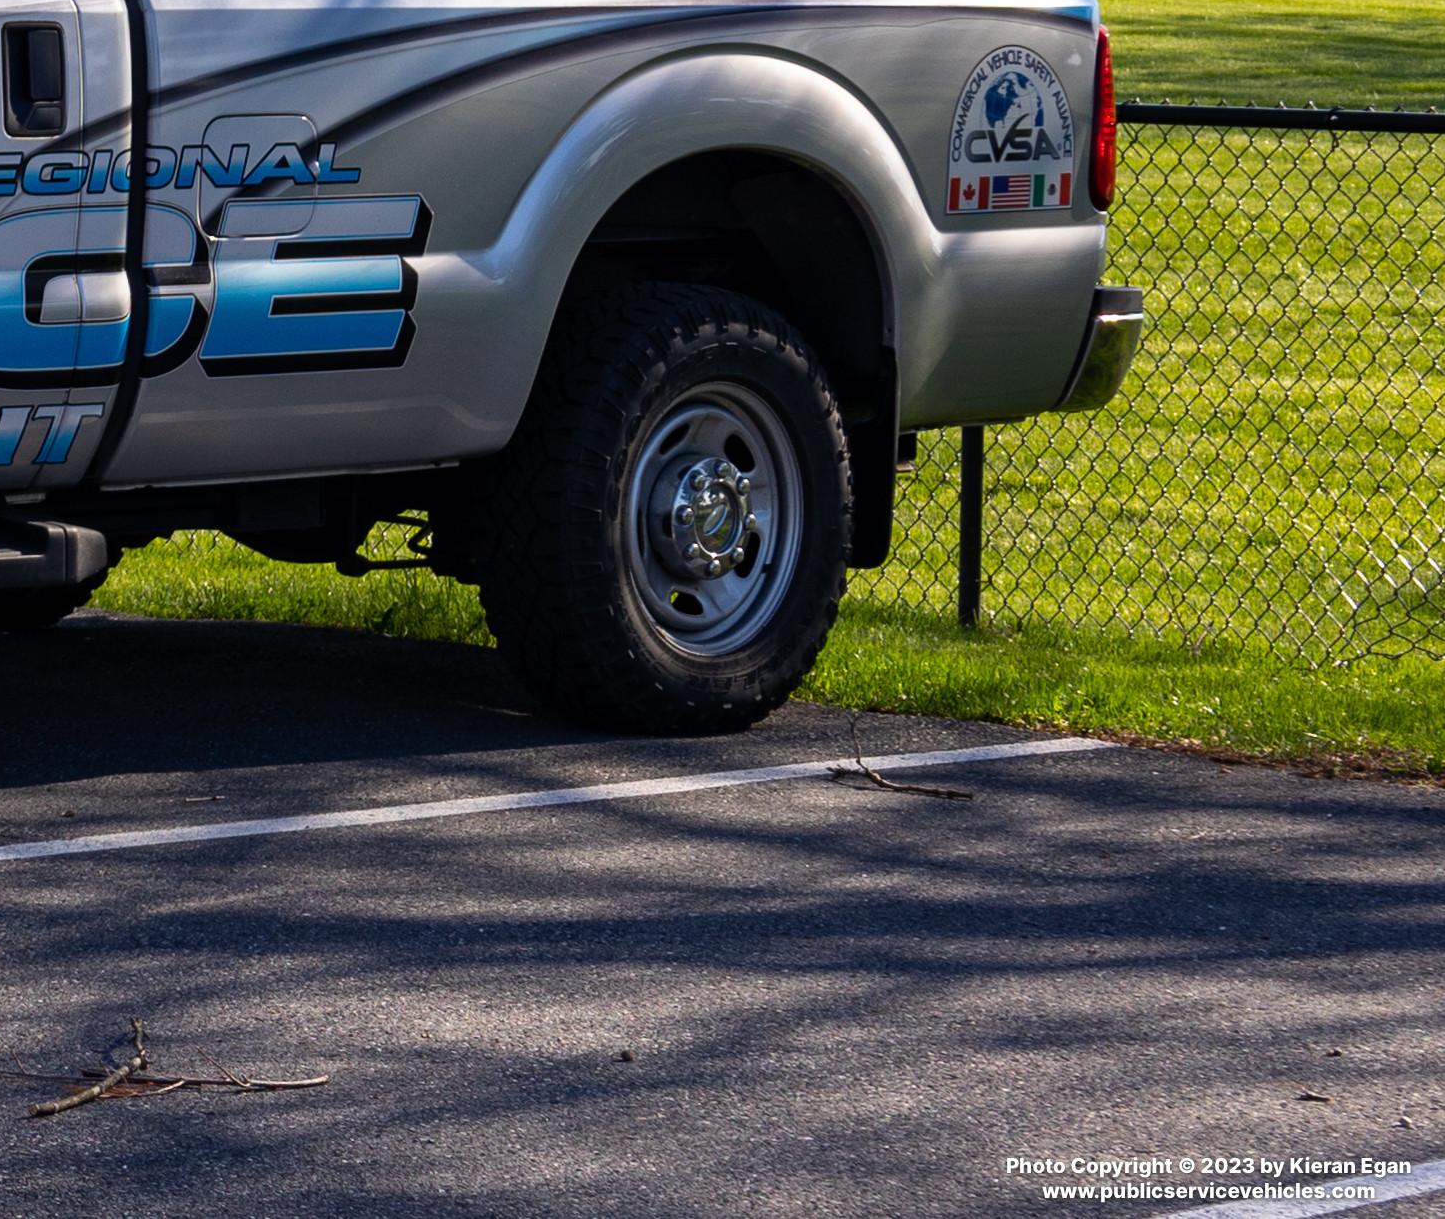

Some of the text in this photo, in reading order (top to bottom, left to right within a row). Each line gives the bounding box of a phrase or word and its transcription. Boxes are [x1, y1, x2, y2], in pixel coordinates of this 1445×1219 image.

[952, 50, 1073, 163] COMMERCIAL VEHICLE SAFETY ALLIANCE
[964, 113, 1061, 164] CVSA
